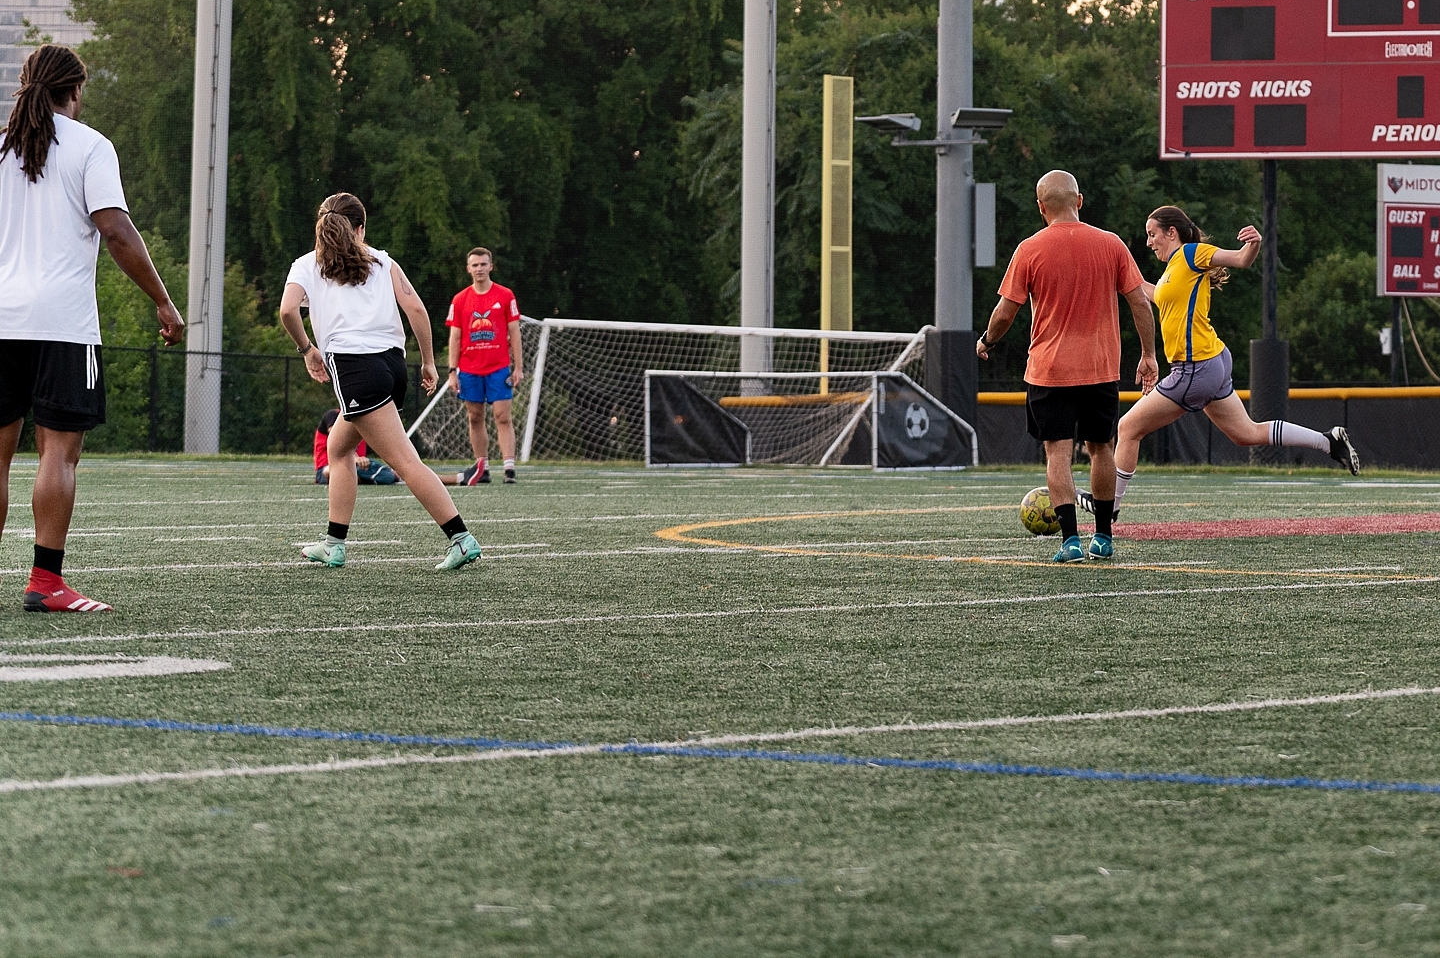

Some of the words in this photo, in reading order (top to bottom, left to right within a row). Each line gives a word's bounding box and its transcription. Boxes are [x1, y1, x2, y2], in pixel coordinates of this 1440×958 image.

[1176, 80, 1242, 100] SHOTS
[1249, 79, 1313, 98] KICKS
[1388, 210, 1426, 224] GUEST
[1430, 230, 1440, 243] H
[1392, 264, 1422, 278] BALL
